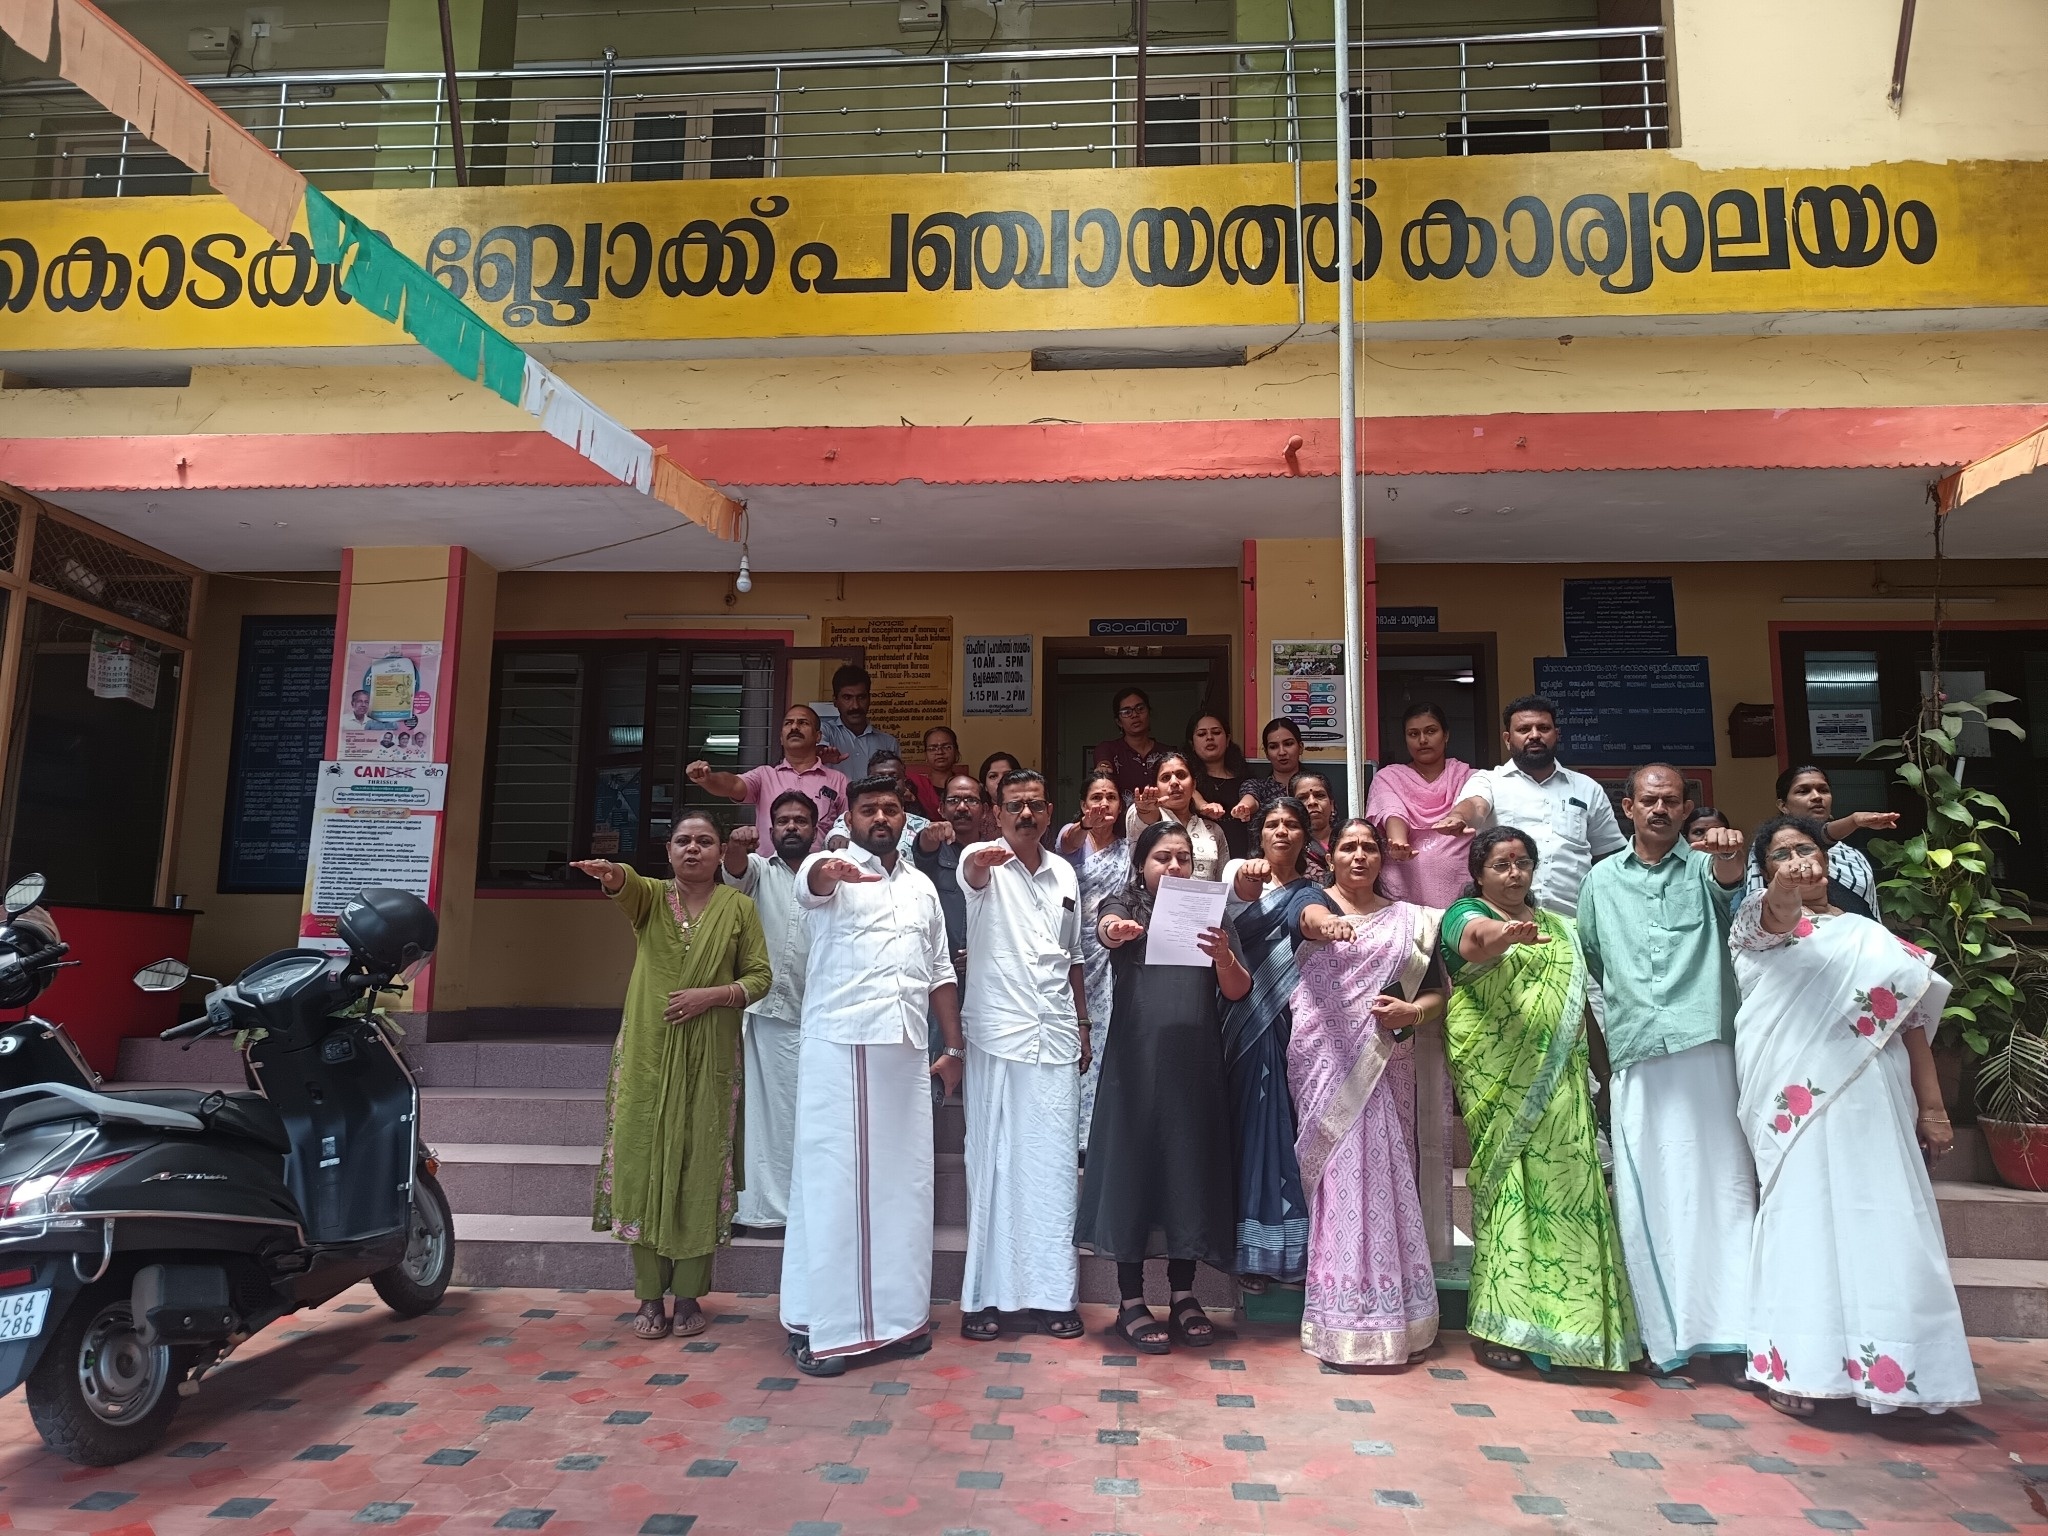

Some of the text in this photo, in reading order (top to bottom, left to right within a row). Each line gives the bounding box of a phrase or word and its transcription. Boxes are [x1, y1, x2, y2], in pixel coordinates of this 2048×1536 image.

[426, 195, 789, 327] ബ്ലോക്ക്
[790, 177, 1383, 293] പഞ്ചായത്ത്
[1400, 184, 1938, 294] കാര്യാലയം
[872, 627, 908, 635] acceptance
[910, 625, 917, 633] of
[918, 627, 937, 635] money
[831, 635, 846, 644] gifts
[882, 636, 901, 644] Report
[903, 636, 913, 644] any
[865, 653, 905, 662] uperintendent
[973, 657, 982, 668] 10
[984, 656, 995, 668] AM
[1006, 656, 1010, 667] 5
[1012, 656, 1023, 667] PM
[987, 691, 998, 701] PM
[1007, 691, 1011, 701] 2
[1013, 690, 1025, 701] PM
[0, 1294, 35, 1318] L64
